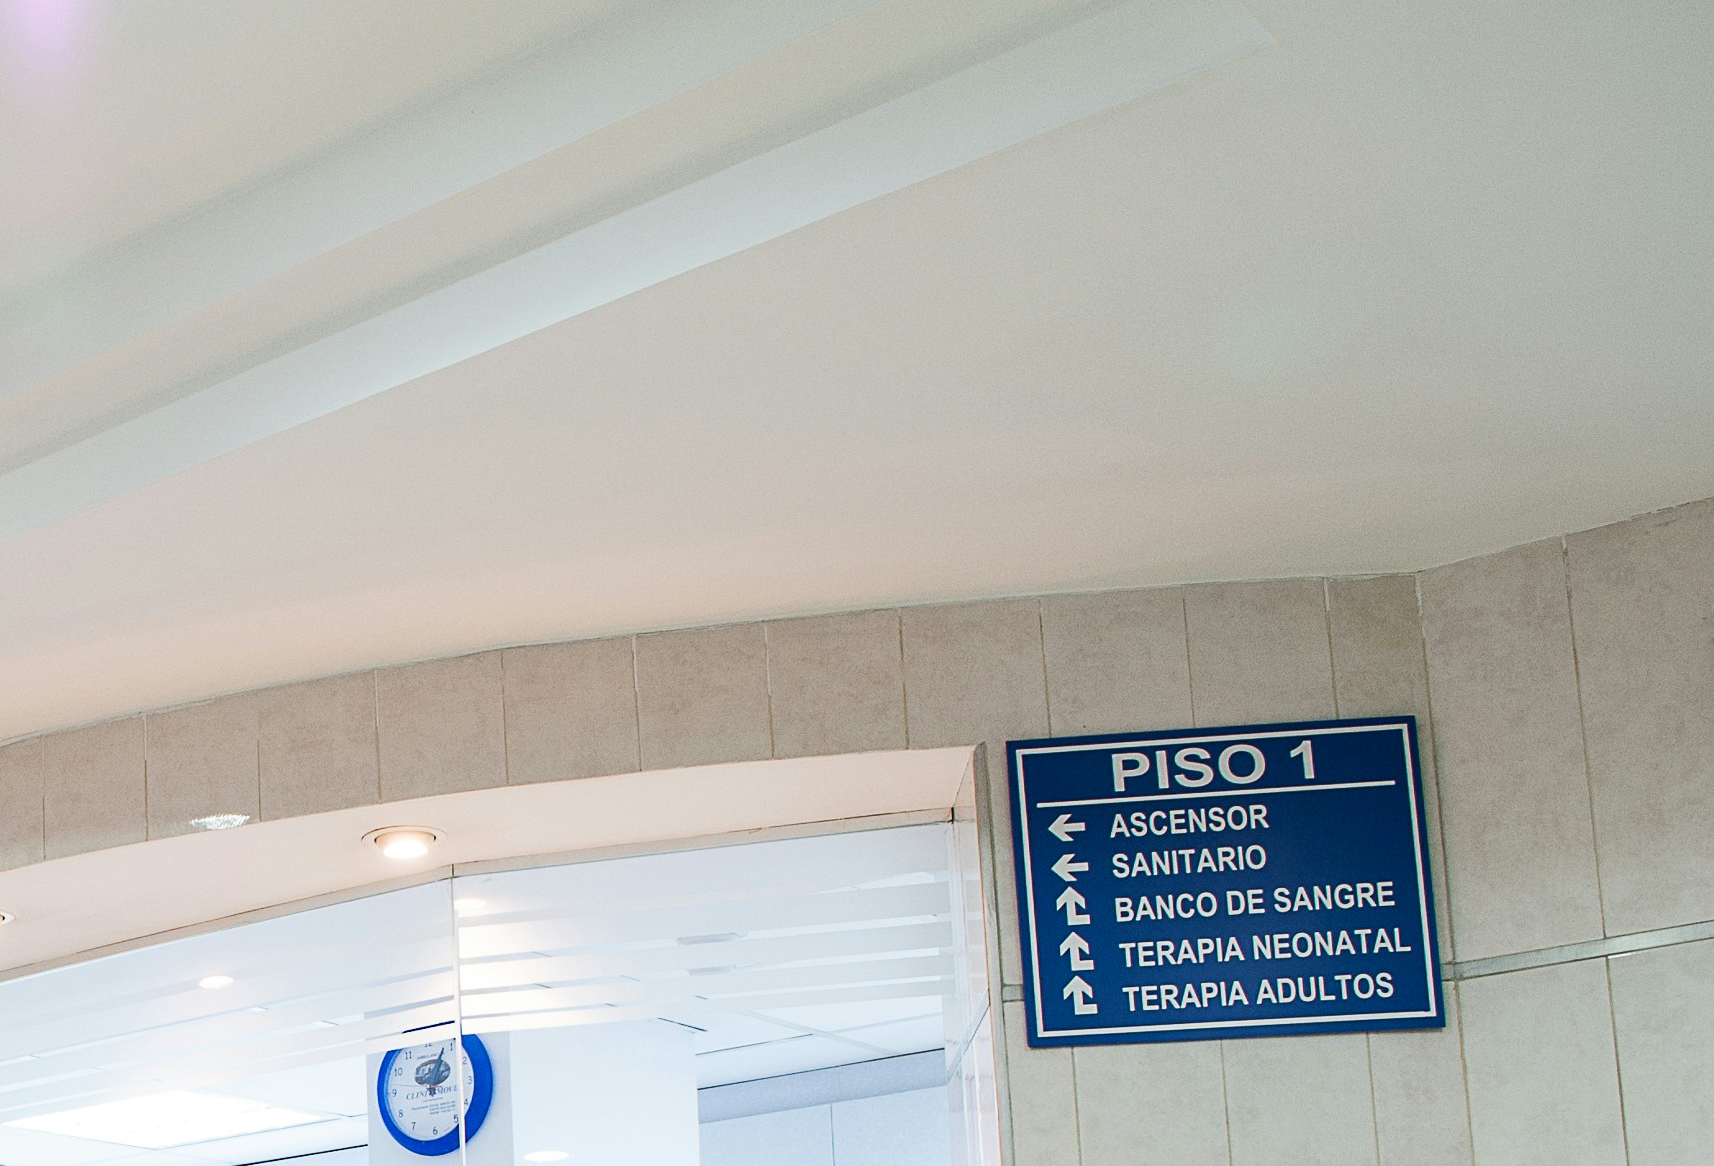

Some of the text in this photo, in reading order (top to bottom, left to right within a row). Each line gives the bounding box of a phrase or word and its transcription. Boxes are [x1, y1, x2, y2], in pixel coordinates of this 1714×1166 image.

[1111, 740, 1315, 792] PISO 1
[1110, 804, 1270, 838] ASCENSOR
[1112, 844, 1267, 879] SANITARIO
[1115, 881, 1395, 923] BANCO DE SANGRE
[1119, 927, 1412, 968] TERAPIA NEONATAL
[1122, 972, 1394, 1012] TERAPIA ADULTOS
[394, 1068, 403, 1077] 10
[391, 1089, 397, 1098] 9
[398, 1109, 404, 1118] 8
[453, 1114, 459, 1123] 5
[411, 1122, 417, 1131] 7
[432, 1126, 438, 1135] 6
